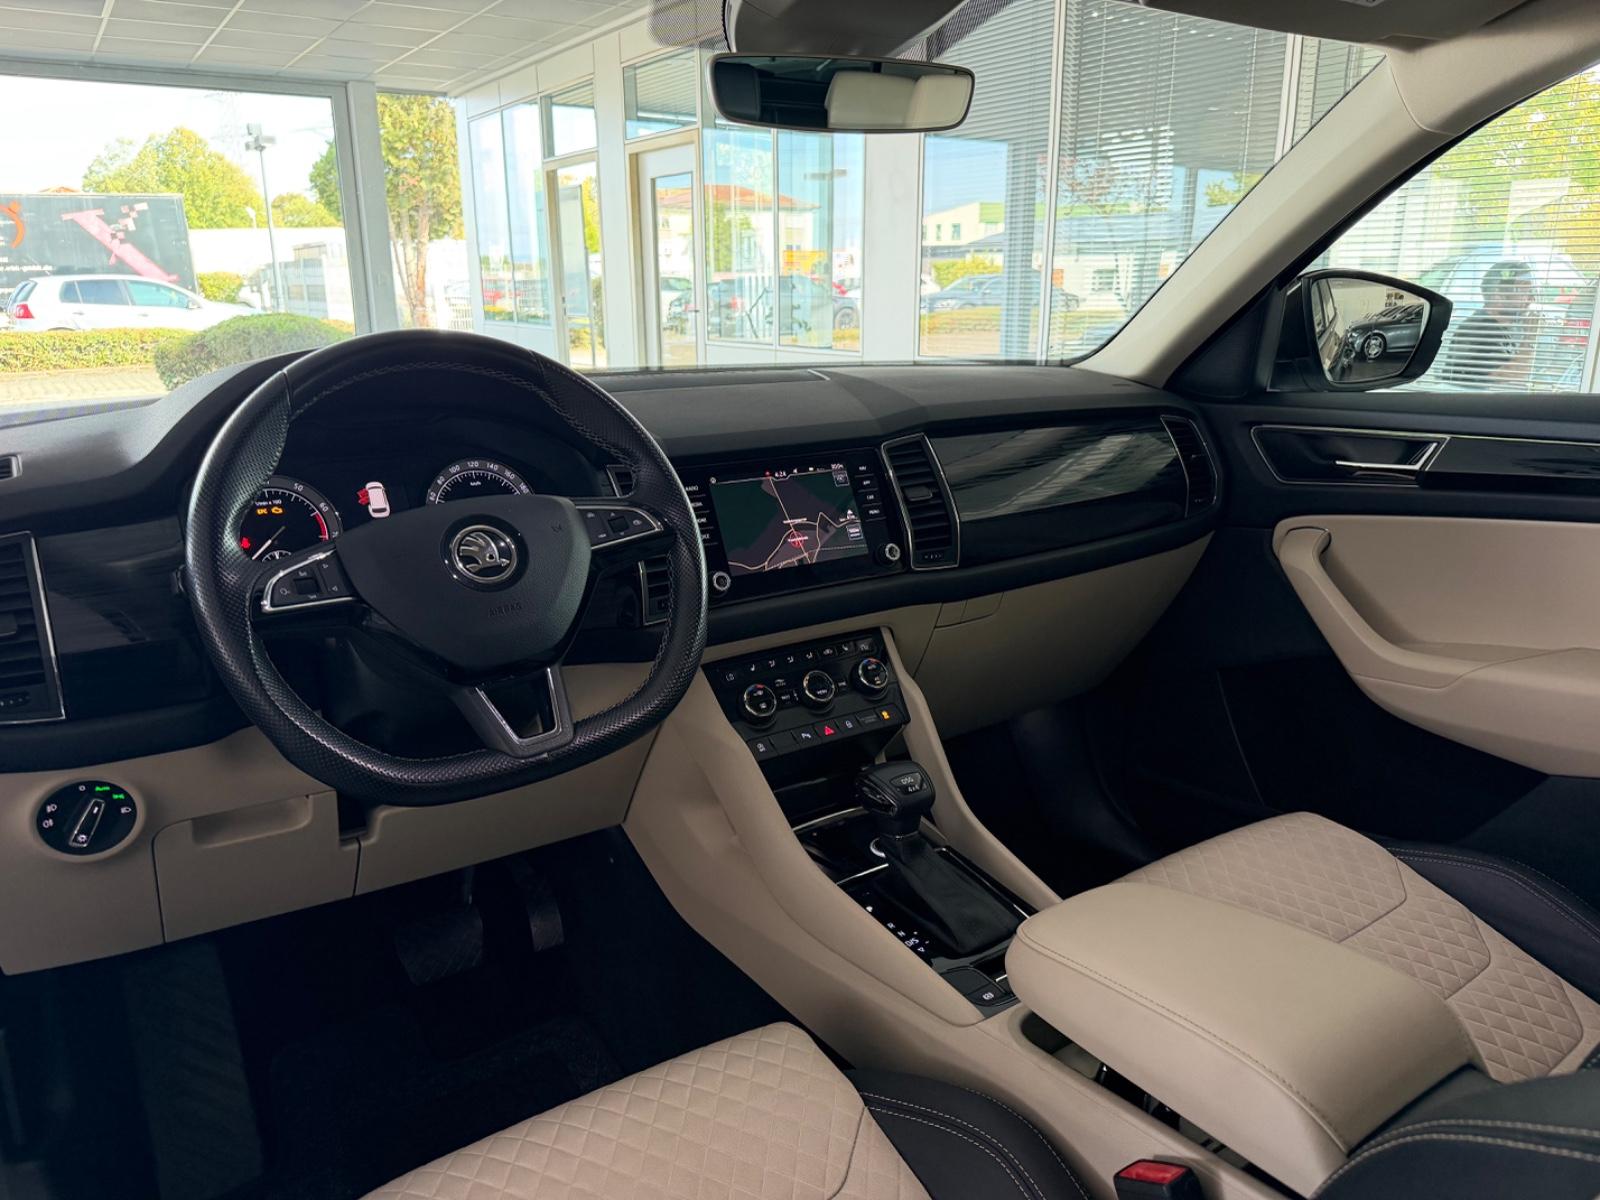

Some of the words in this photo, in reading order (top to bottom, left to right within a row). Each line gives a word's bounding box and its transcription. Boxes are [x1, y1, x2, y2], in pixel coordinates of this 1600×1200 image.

[448, 464, 461, 474] 100
[467, 460, 479, 468] 120
[486, 462, 498, 471] 140
[504, 468, 516, 480] 160
[437, 475, 445, 485] 80
[293, 482, 304, 492] 50
[519, 482, 530, 494] 180
[318, 502, 329, 513] 60
[900, 776, 914, 785] DSG
